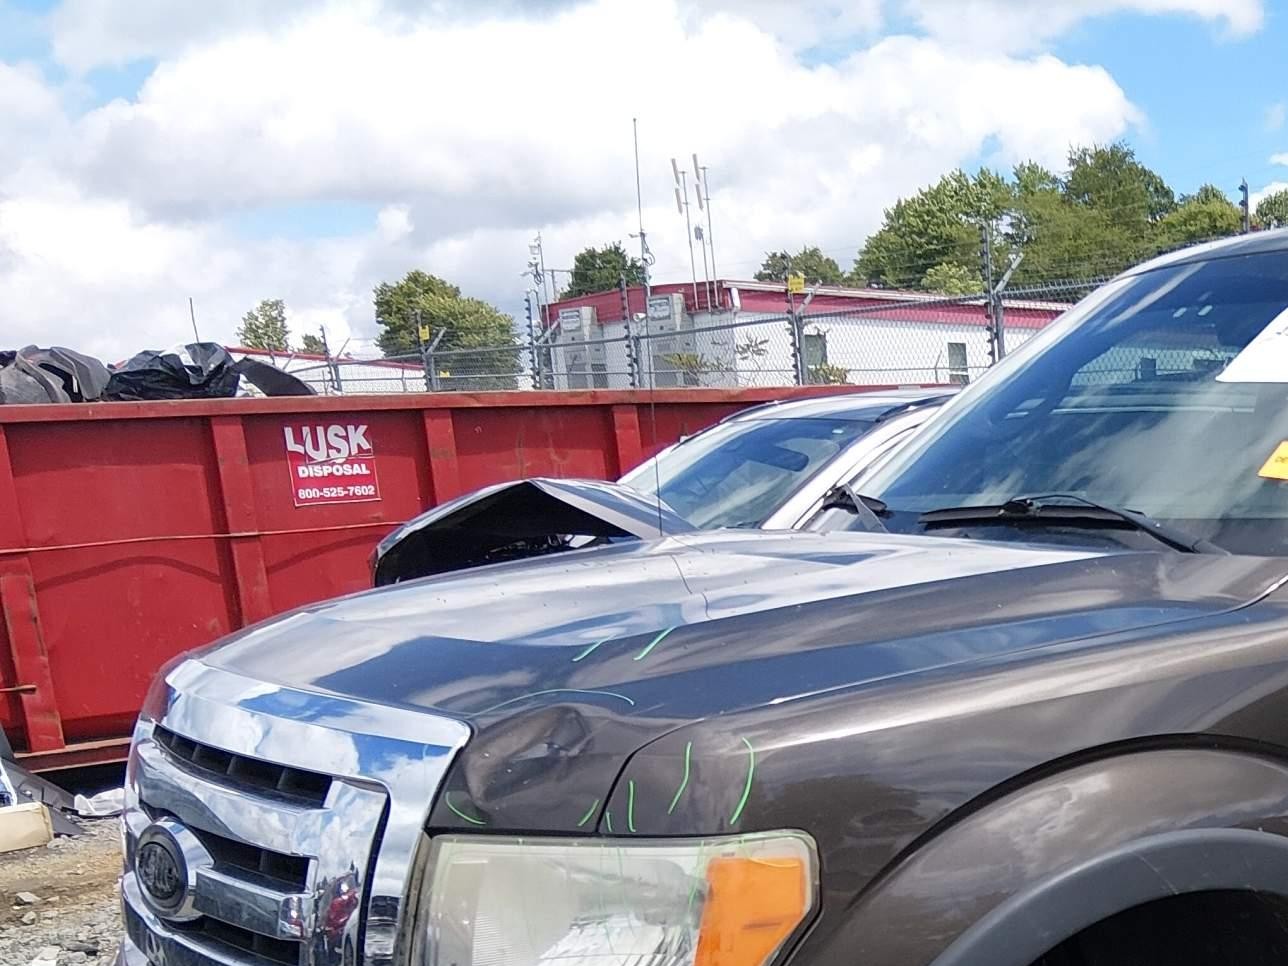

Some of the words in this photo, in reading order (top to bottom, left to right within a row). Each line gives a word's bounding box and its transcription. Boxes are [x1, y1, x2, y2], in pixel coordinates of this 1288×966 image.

[284, 424, 372, 464] LUSK
[297, 463, 371, 478] DISPOSAL
[298, 485, 376, 499] 800-525-7602
